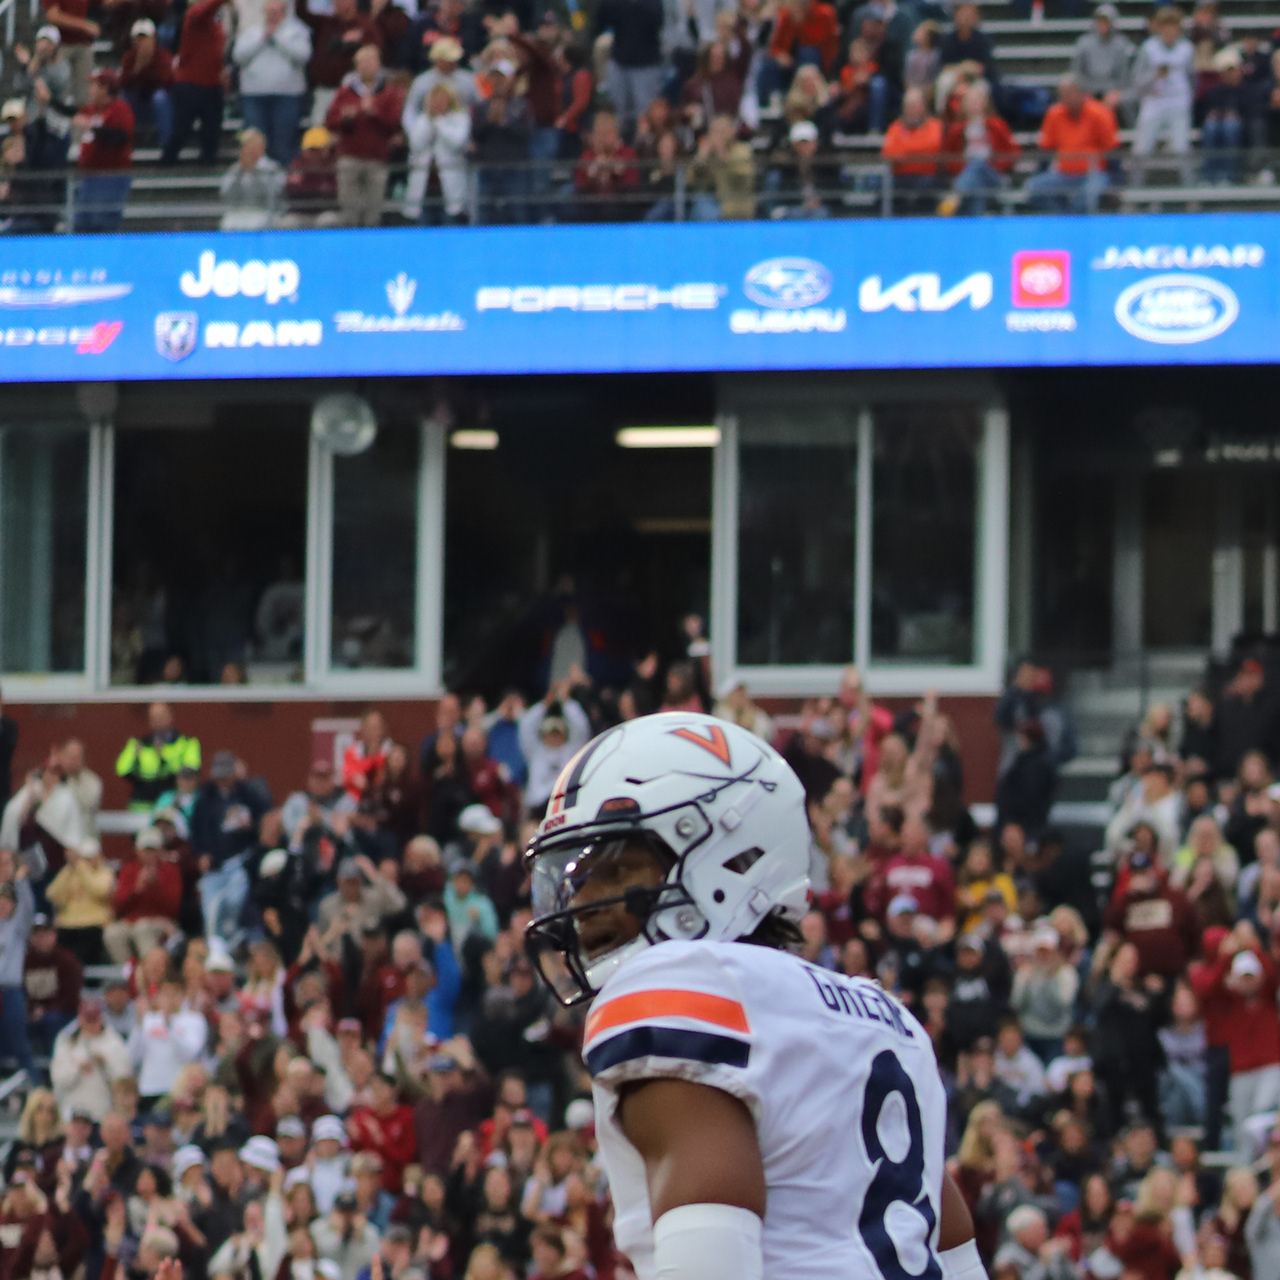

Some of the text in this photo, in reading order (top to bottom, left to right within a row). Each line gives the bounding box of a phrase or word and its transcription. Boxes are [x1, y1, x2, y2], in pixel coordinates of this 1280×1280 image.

[1090, 245, 1265, 270] JAGUAR
[180, 250, 300, 305] Jeep
[477, 285, 720, 312] PORSCHE
[859, 272, 993, 312] KIA
[205, 320, 322, 348] RAM
